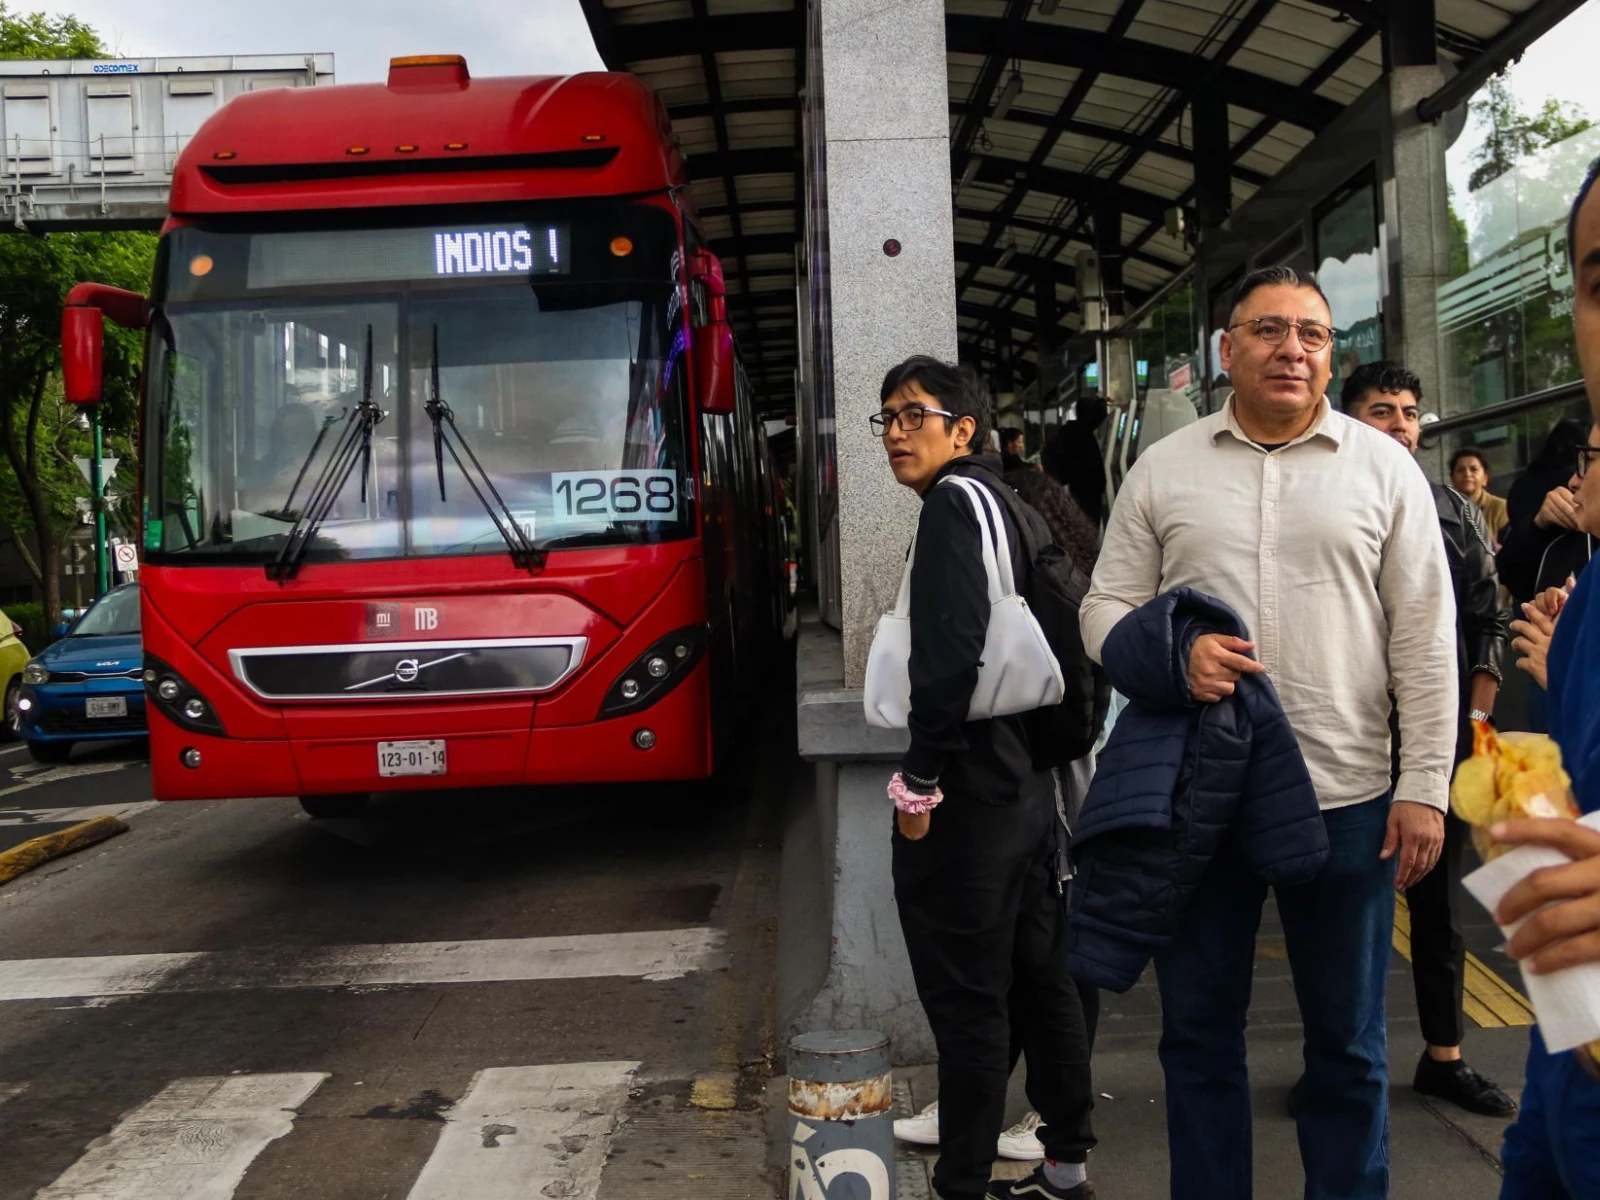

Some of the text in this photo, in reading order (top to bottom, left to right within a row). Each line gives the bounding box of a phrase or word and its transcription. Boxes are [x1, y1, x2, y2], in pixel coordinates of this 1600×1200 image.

[434, 230, 532, 274] INDIOS
[555, 476, 675, 516] 1268
[381, 750, 445, 767] 123-01-14
